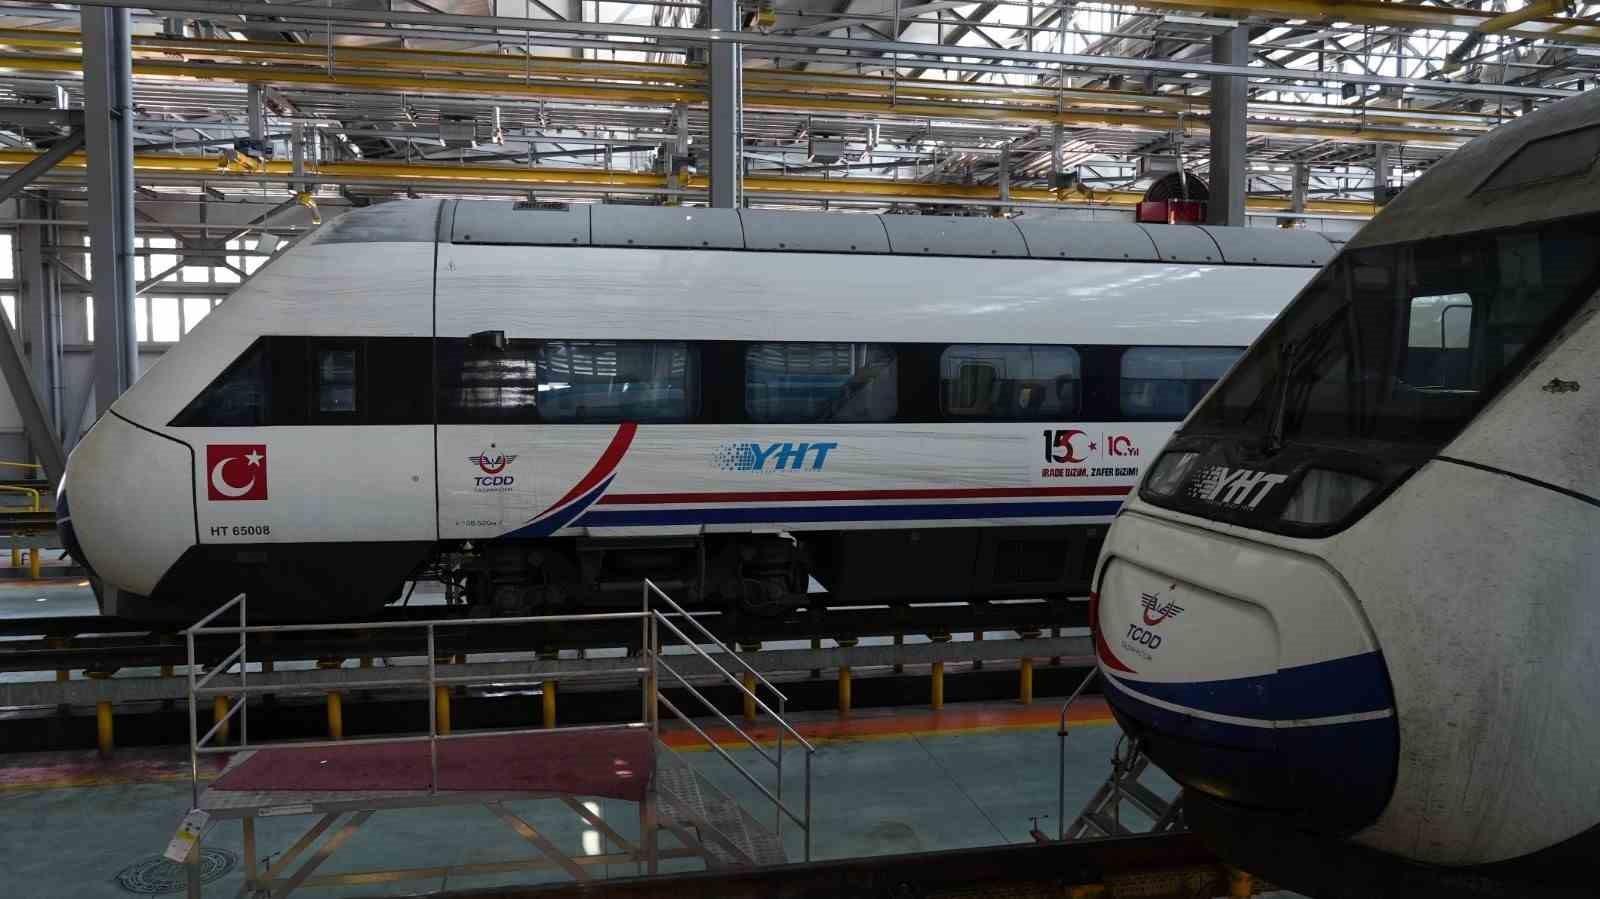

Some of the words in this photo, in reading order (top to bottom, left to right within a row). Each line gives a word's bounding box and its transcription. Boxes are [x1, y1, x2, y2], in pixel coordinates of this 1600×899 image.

[751, 442, 838, 470] YHT
[1043, 430, 1081, 463] 15
[474, 476, 514, 486] TCDD
[1091, 467, 1114, 477] ZAFER
[1208, 467, 1288, 507] YHT
[210, 526, 229, 537] HT
[232, 526, 271, 536] 65008
[1126, 624, 1162, 649] TCDD
